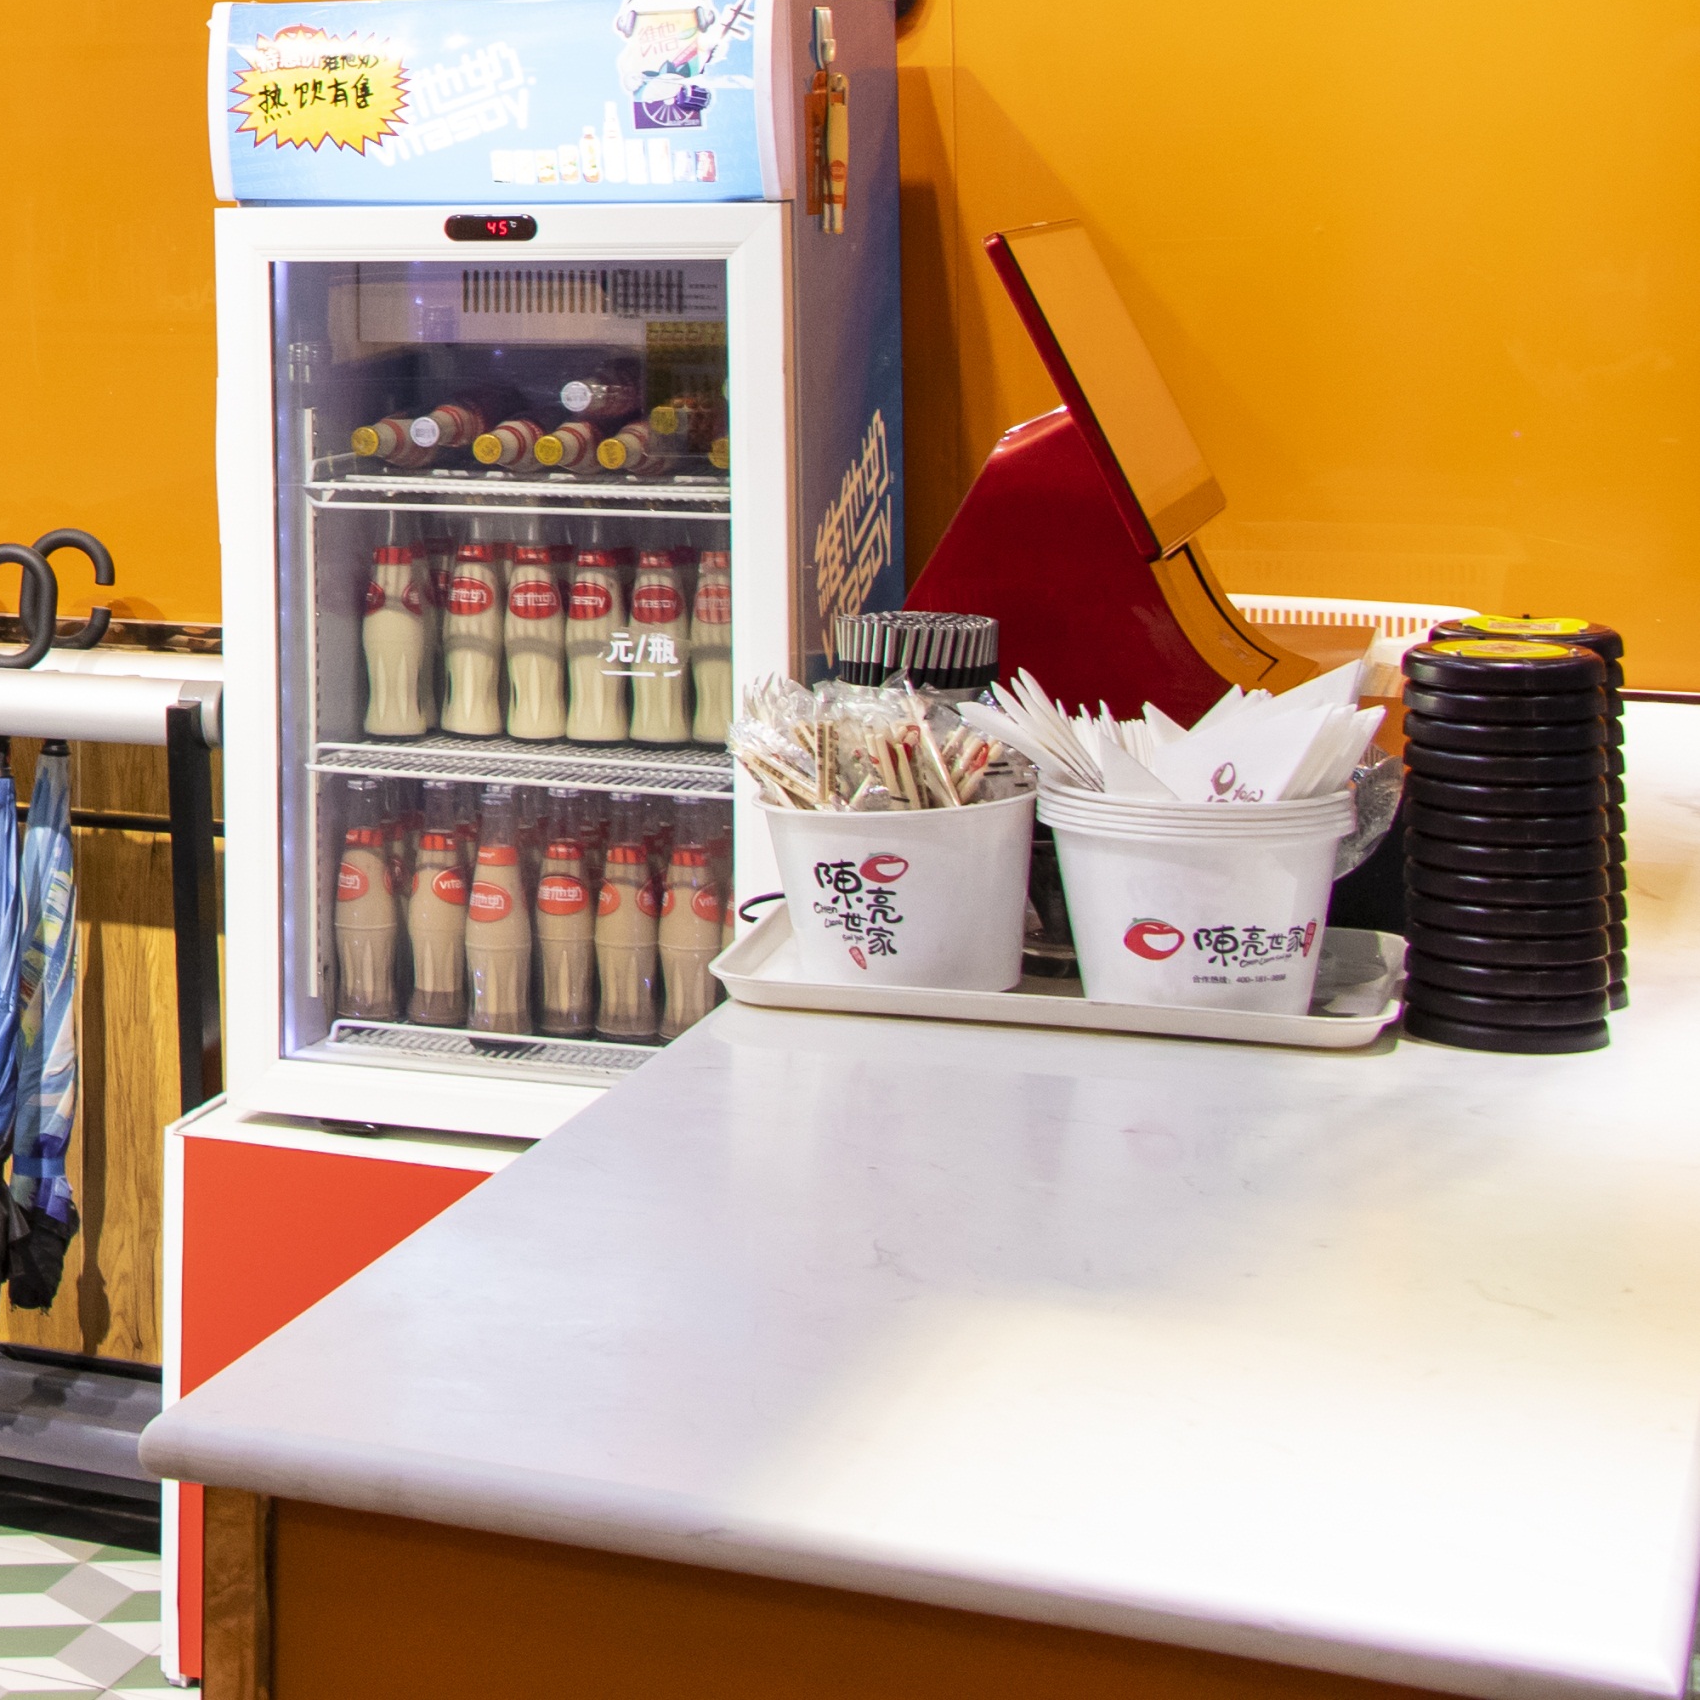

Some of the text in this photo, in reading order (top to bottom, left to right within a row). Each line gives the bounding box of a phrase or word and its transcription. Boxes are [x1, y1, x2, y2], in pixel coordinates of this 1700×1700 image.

[605, 631, 679, 664] 元/瓶
[813, 859, 904, 956] 陳亮世家
[1192, 924, 1306, 967] 陳亮世家
